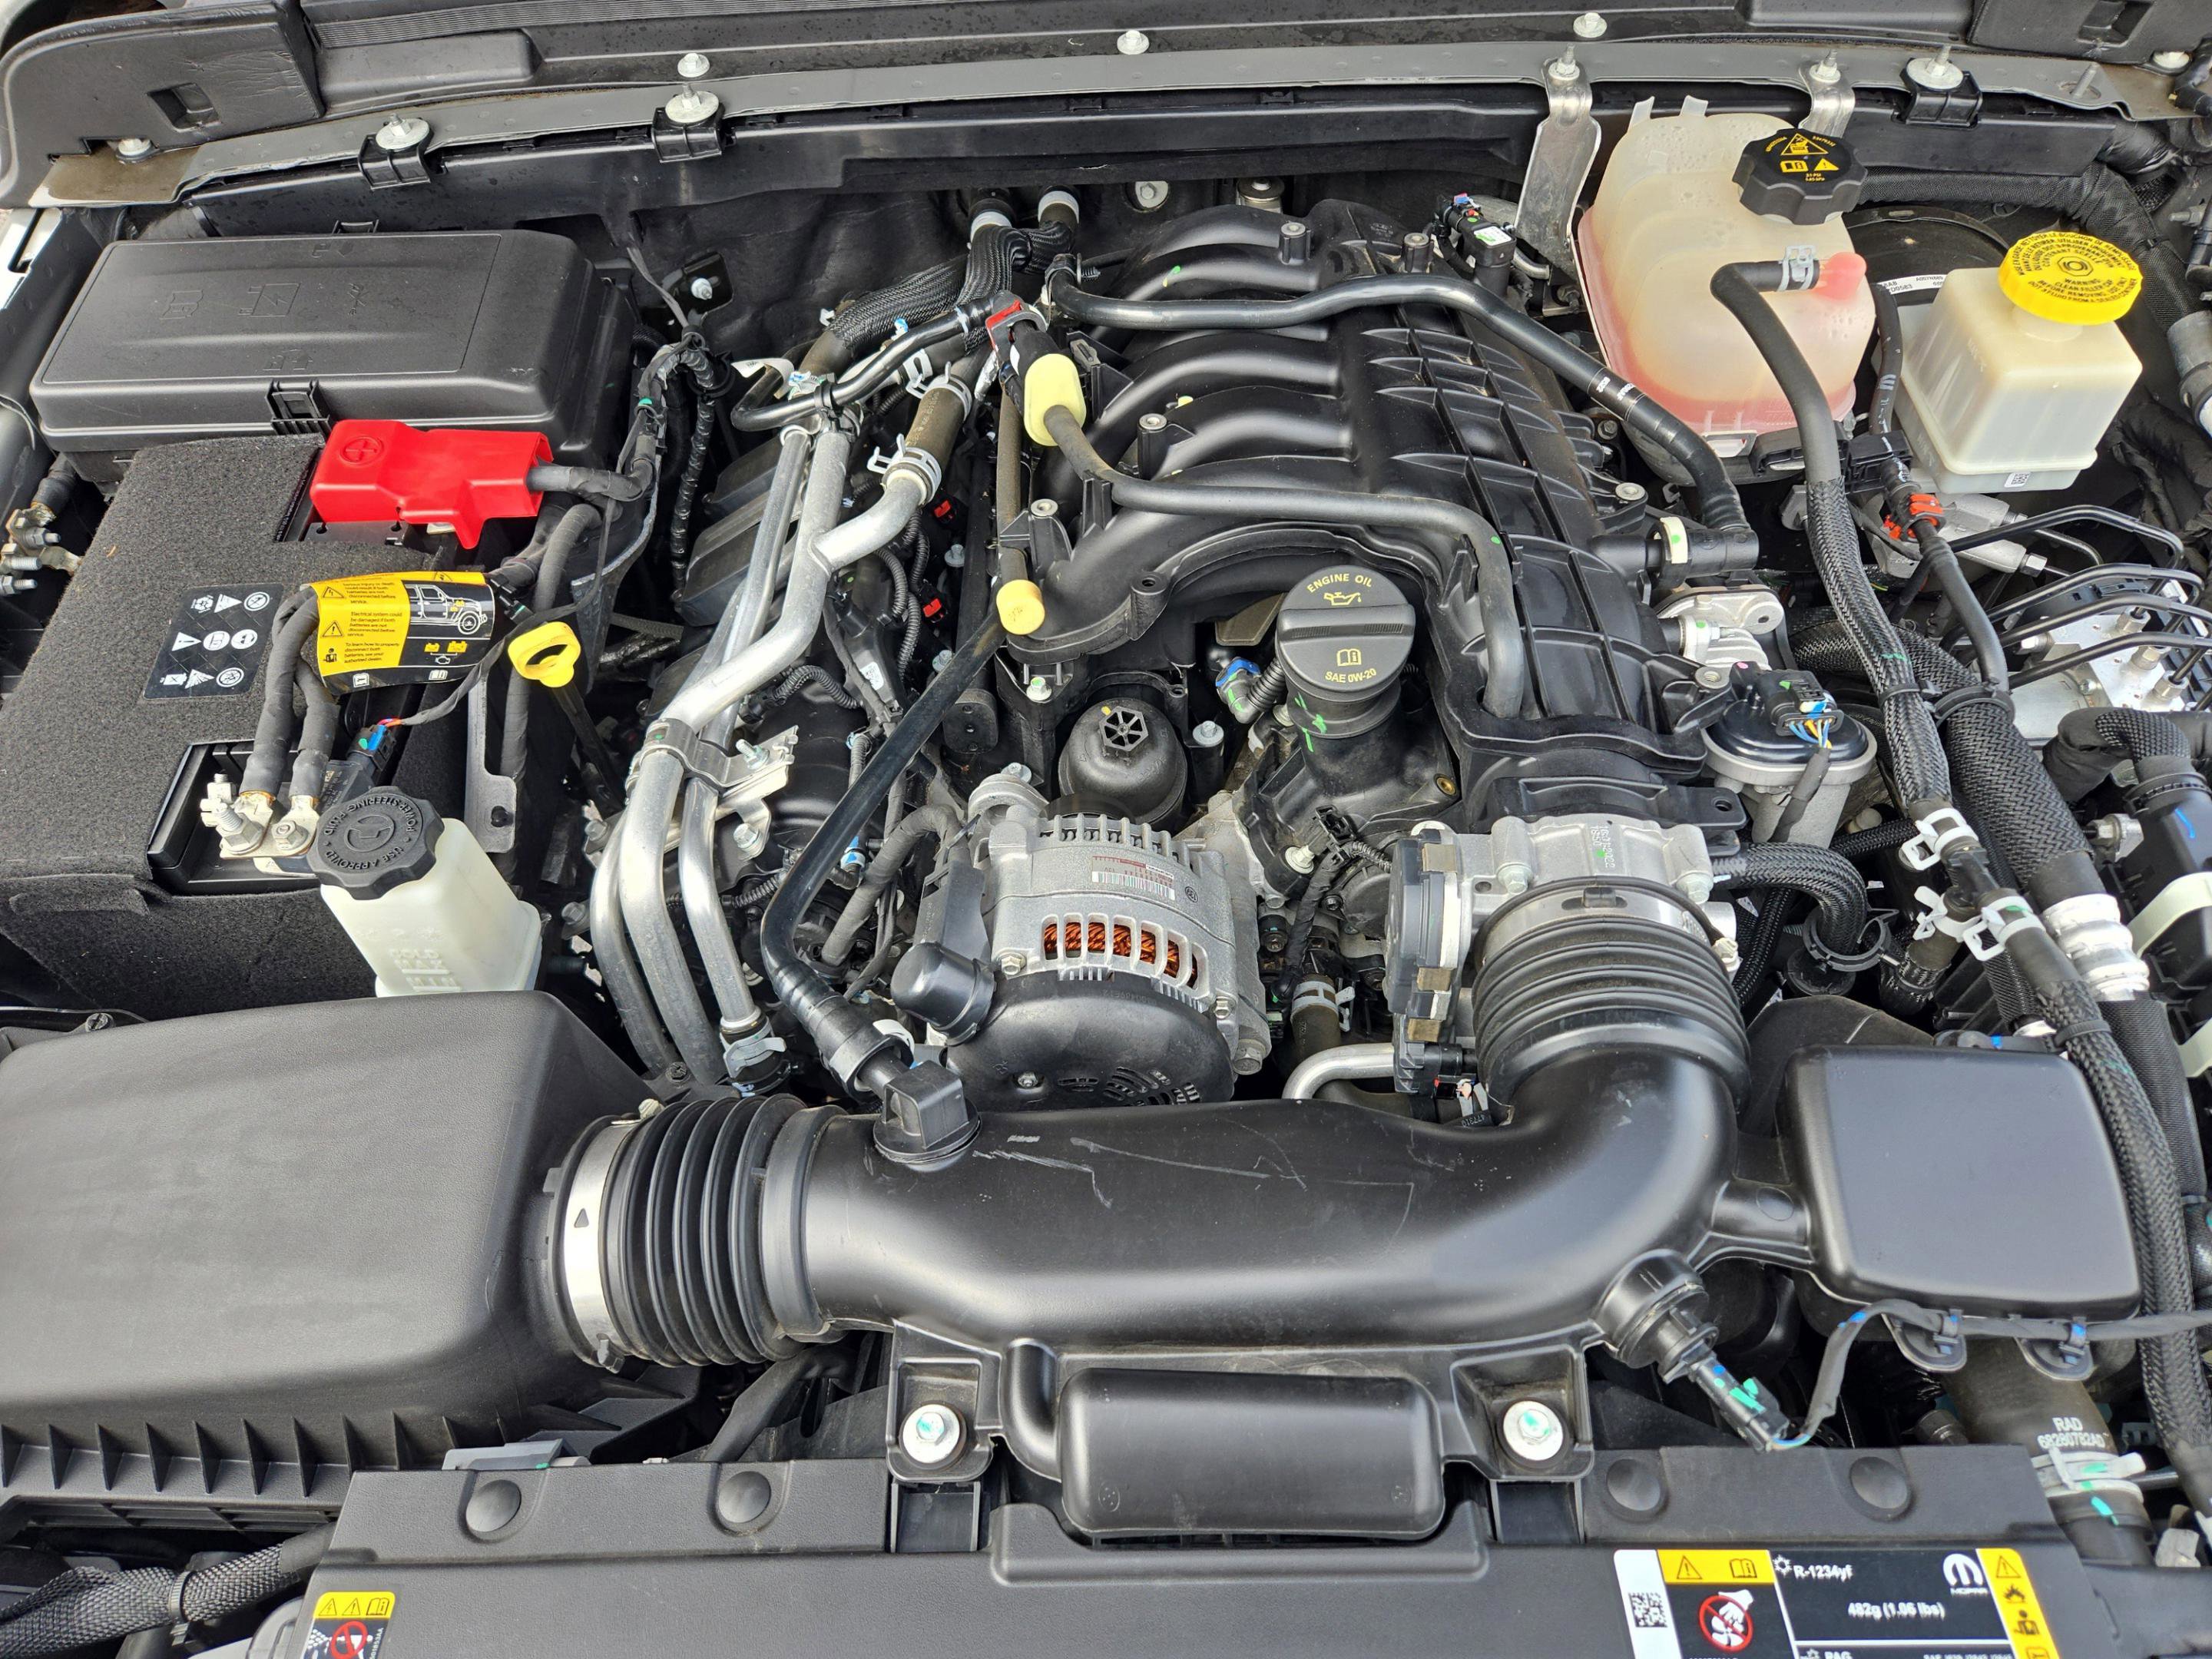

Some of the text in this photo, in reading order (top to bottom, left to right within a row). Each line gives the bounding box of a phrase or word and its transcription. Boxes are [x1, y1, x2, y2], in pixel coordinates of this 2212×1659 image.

[1306, 573, 1373, 593] ENGINE OIL
[1325, 667, 1377, 684] SAE 0W-20
[323, 796, 418, 836] POWER STEERING FLUID
[325, 846, 405, 870] USE APPROVED
[389, 948, 440, 959] COLD
[393, 959, 445, 969] MAX
[405, 976, 457, 986] MIN
[2051, 1417, 2084, 1432] RAD
[1793, 1564, 1853, 1582] R-1234yf
[1847, 1601, 1883, 1621] 482g
[1917, 1601, 1946, 1621] lbs)
